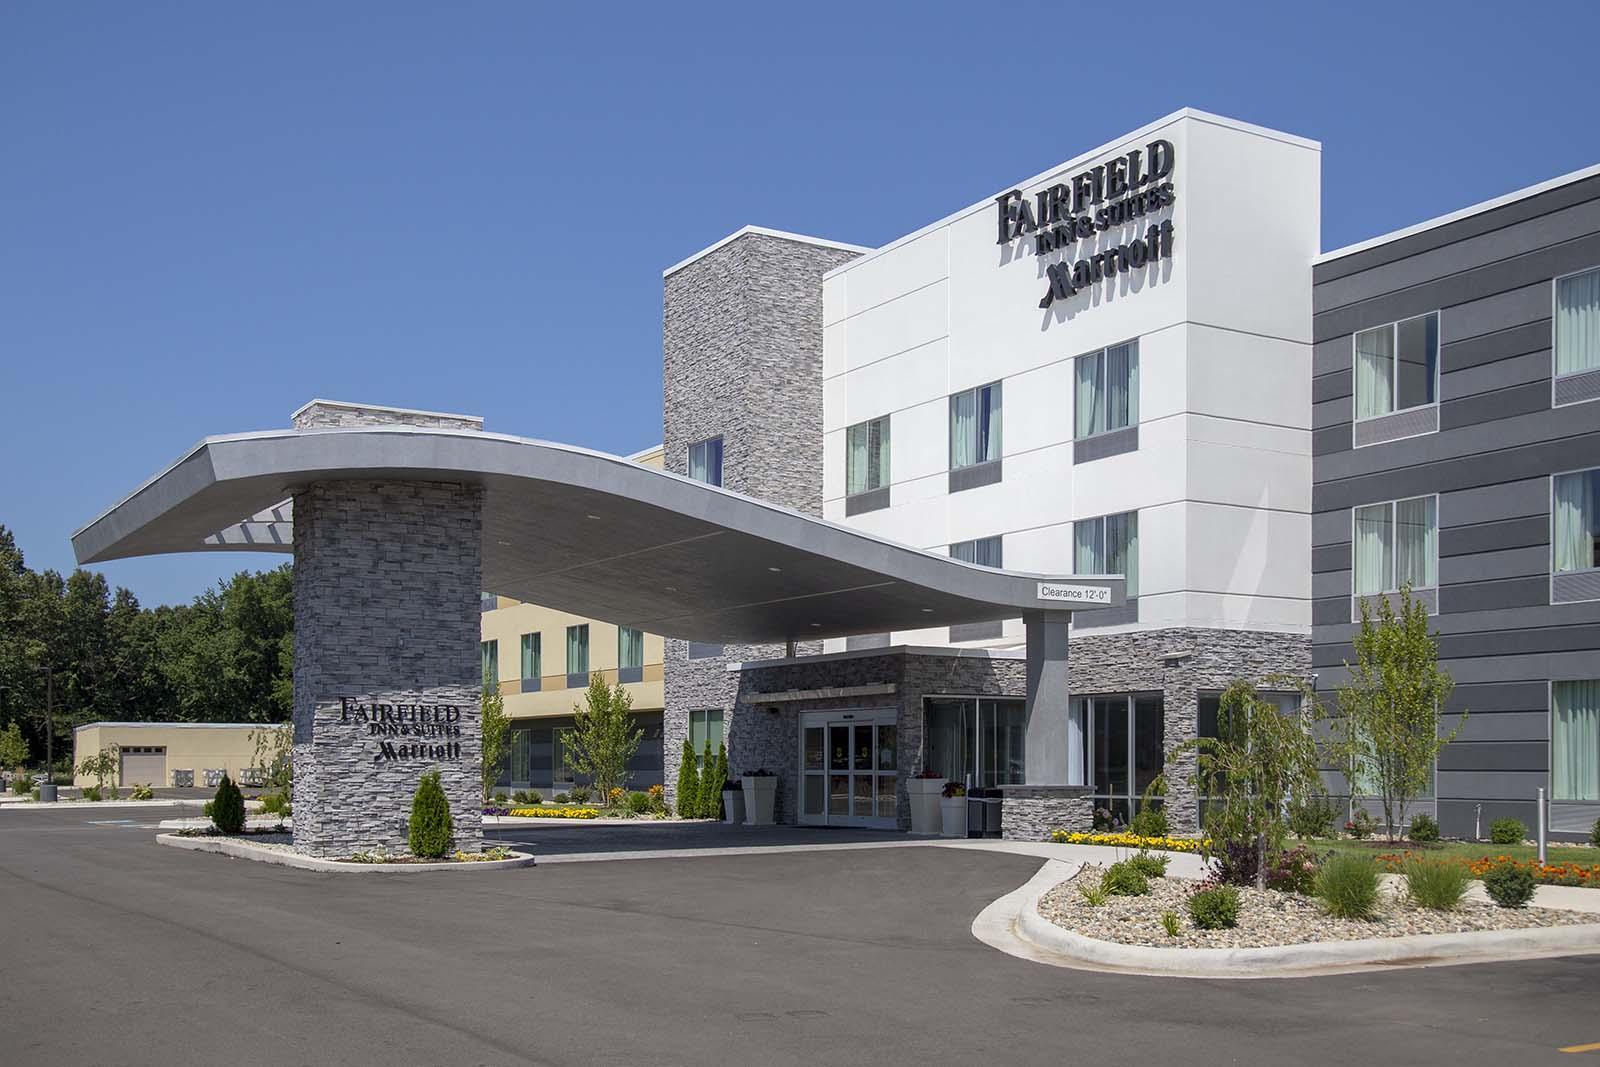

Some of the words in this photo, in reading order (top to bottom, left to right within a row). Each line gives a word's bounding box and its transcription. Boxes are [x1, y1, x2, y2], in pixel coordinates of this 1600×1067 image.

[995, 139, 1175, 245] FAIRFIELD
[1034, 219, 1078, 256] INN
[1096, 182, 1176, 232] SUITES
[1038, 218, 1174, 308] Marriott
[1042, 586, 1082, 598] Clearance
[339, 696, 460, 723] FAIRFIELD
[369, 723, 398, 736] INN
[413, 723, 460, 738] SUITES
[374, 740, 460, 760] Marriott
